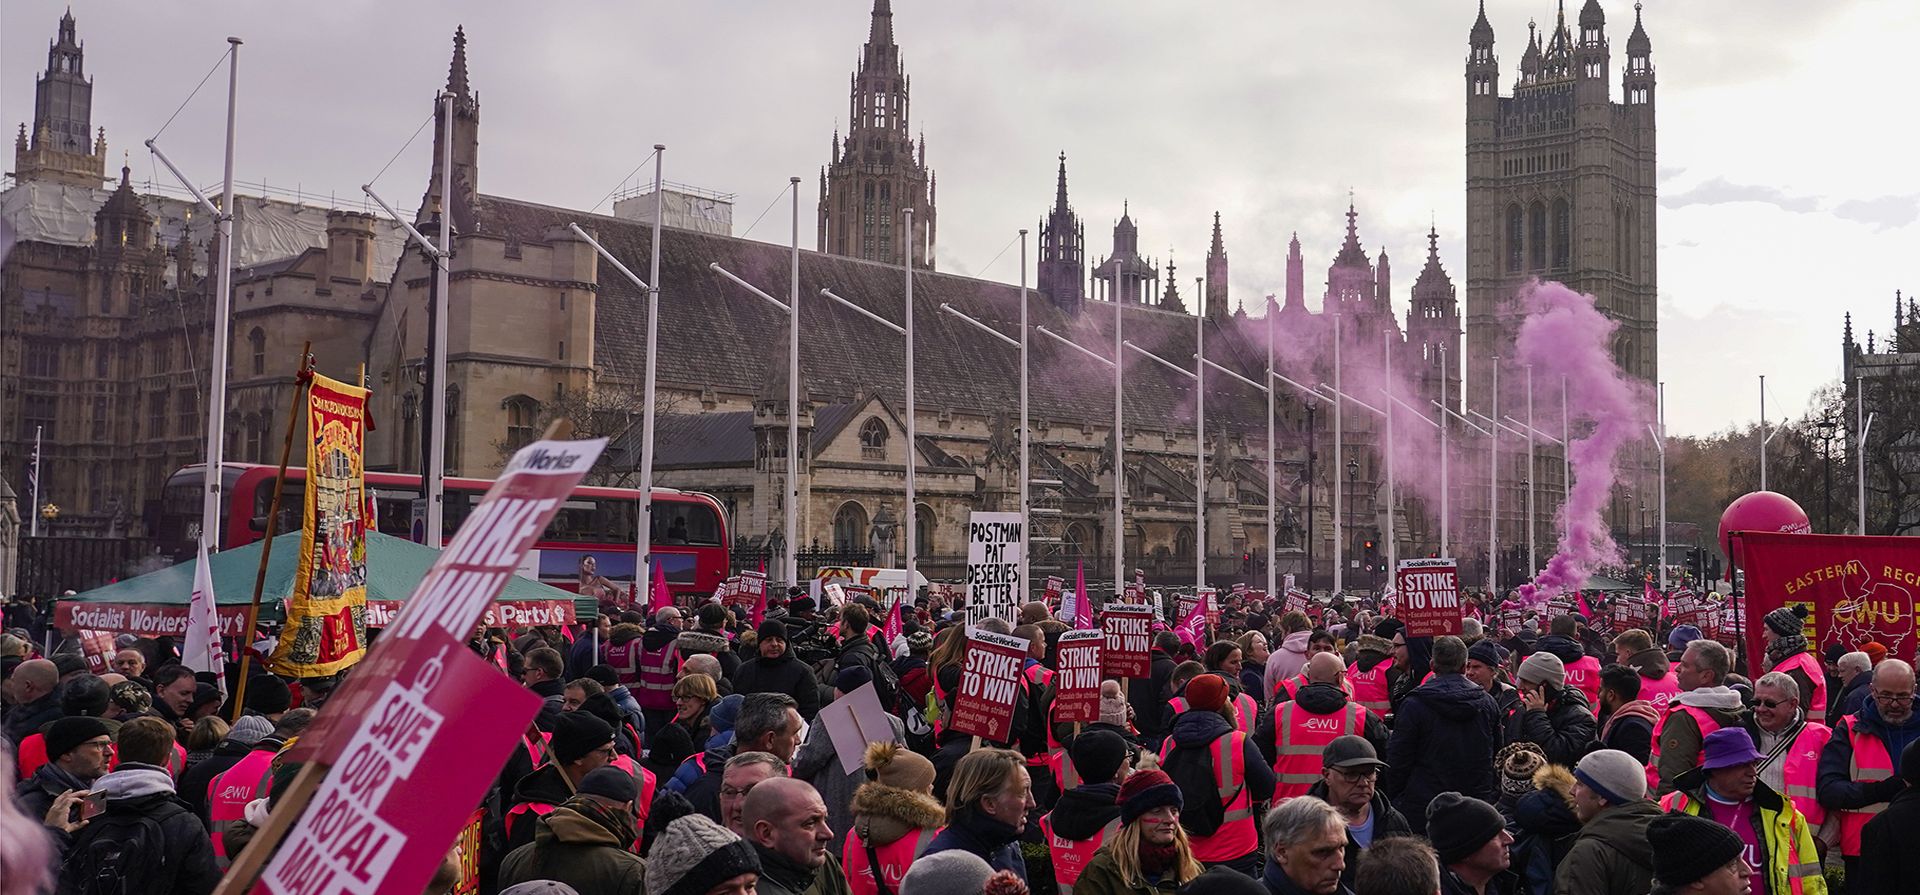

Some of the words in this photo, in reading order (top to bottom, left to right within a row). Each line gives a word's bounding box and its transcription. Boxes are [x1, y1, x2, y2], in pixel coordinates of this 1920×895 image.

[524, 448, 580, 469] Worker
[970, 523, 1022, 542] POSTMAN
[985, 544, 1006, 563] PAT
[740, 576, 764, 586] STRIKE
[968, 564, 1018, 584] DESERVES
[1404, 572, 1456, 592] STRIKE
[1784, 563, 1858, 595] EASTERN
[740, 584, 748, 592] TO
[750, 586, 762, 595] WIN
[972, 584, 1012, 605] BETTER
[1406, 591, 1426, 610] TO
[1429, 590, 1458, 608] WIN
[71, 606, 124, 629] Socialist
[130, 609, 187, 632] Workers
[500, 606, 550, 626] Party
[966, 605, 990, 626] THAN
[993, 604, 1015, 622] THAT
[1548, 608, 1568, 616] STRIKE
[1830, 600, 1900, 624] CWU
[1106, 617, 1149, 635] STRIKE
[974, 632, 1000, 644] Socialist
[998, 636, 1022, 648] Worker
[1106, 634, 1120, 651] TO
[1124, 635, 1149, 652] WIN
[88, 654, 101, 666] TO
[966, 648, 1022, 681] STRIKE
[1060, 646, 1100, 668] STRIKE
[1058, 668, 1073, 690] TO
[1076, 668, 1100, 688] WIN
[1564, 670, 1585, 682] WU
[962, 671, 980, 696] TO
[982, 676, 1016, 706] WIN
[958, 709, 974, 720] Defend
[974, 713, 988, 723] CWU
[960, 698, 980, 709] Escalate
[980, 702, 990, 712] the
[991, 704, 1010, 717] strikes
[370, 693, 436, 763] SAVE
[955, 720, 976, 731] activists
[1299, 718, 1338, 730] CWU
[339, 742, 393, 811] OUR
[219, 785, 250, 800] CWU
[308, 787, 390, 885] ROYAL
[276, 836, 356, 895] MAIL
